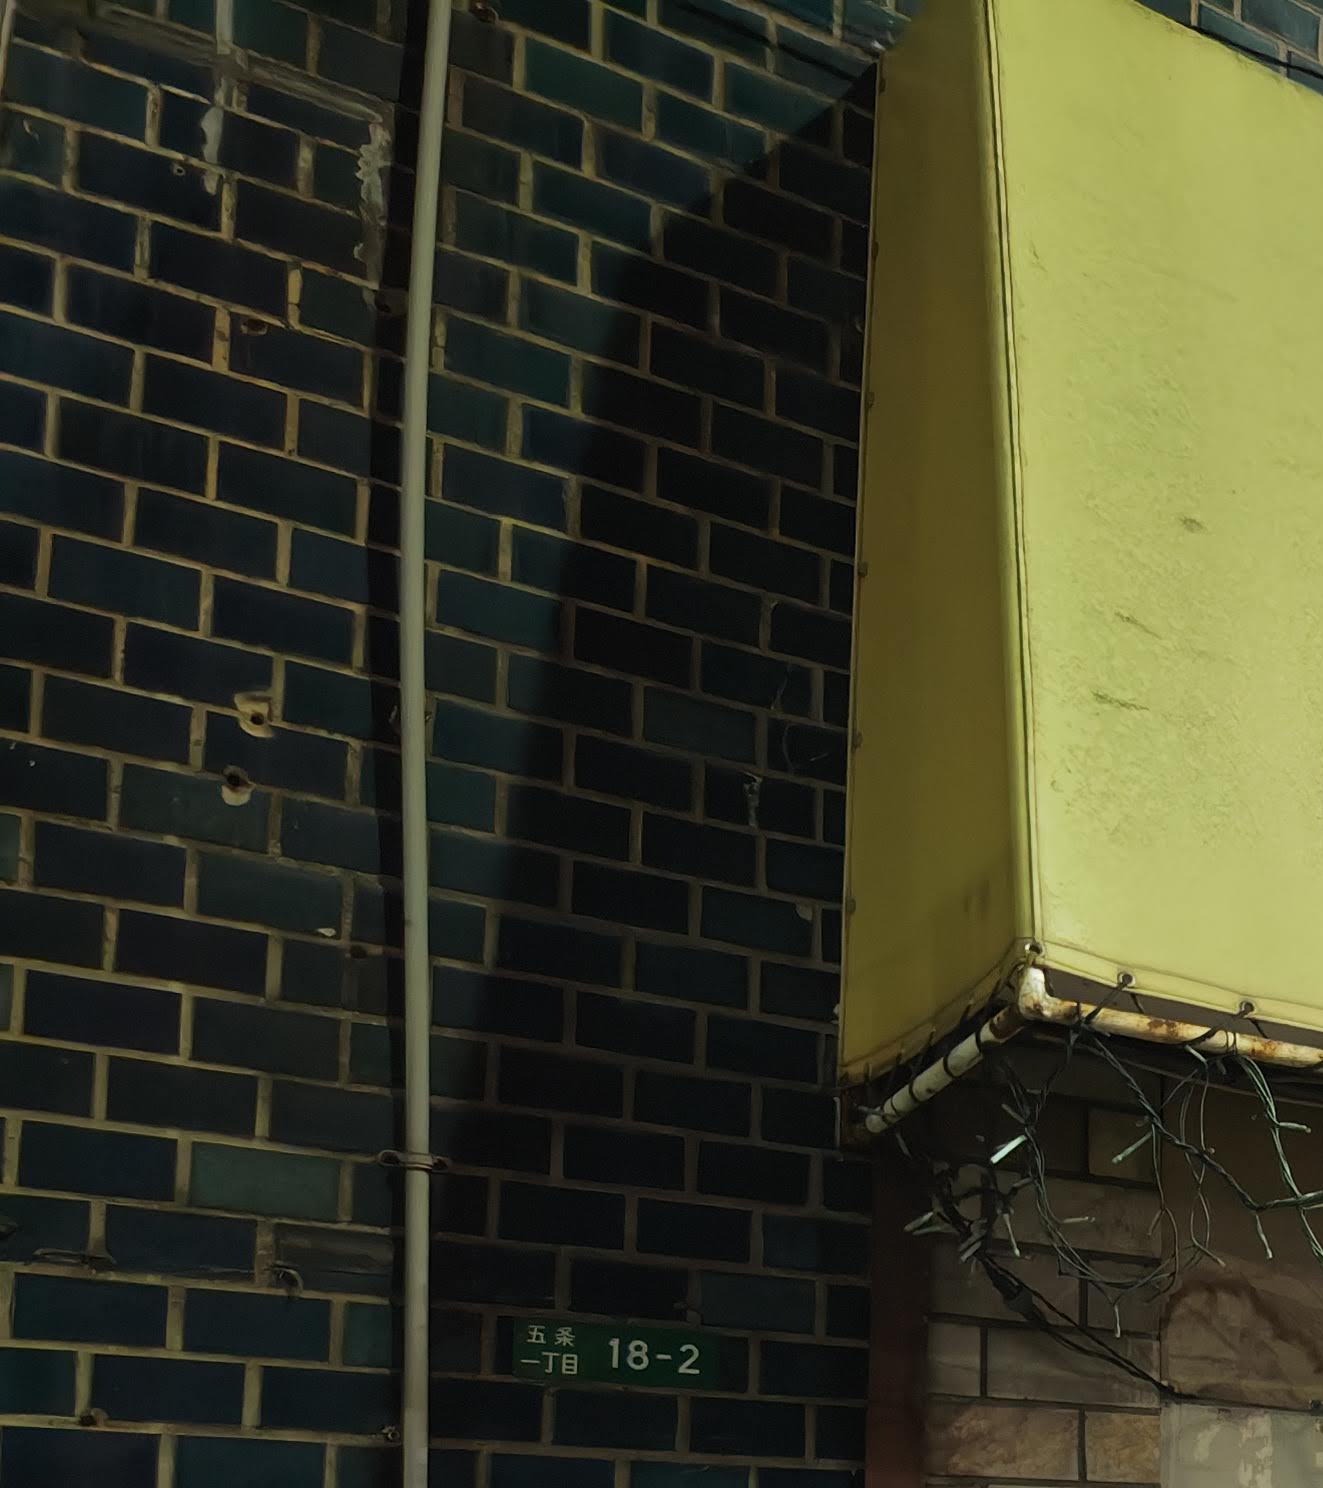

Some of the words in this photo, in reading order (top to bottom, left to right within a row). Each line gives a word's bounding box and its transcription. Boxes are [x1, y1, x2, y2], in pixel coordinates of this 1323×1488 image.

[527, 1325, 575, 1347] 五条
[520, 1352, 578, 1375] 一丁目
[608, 1338, 700, 1375] 18-2
